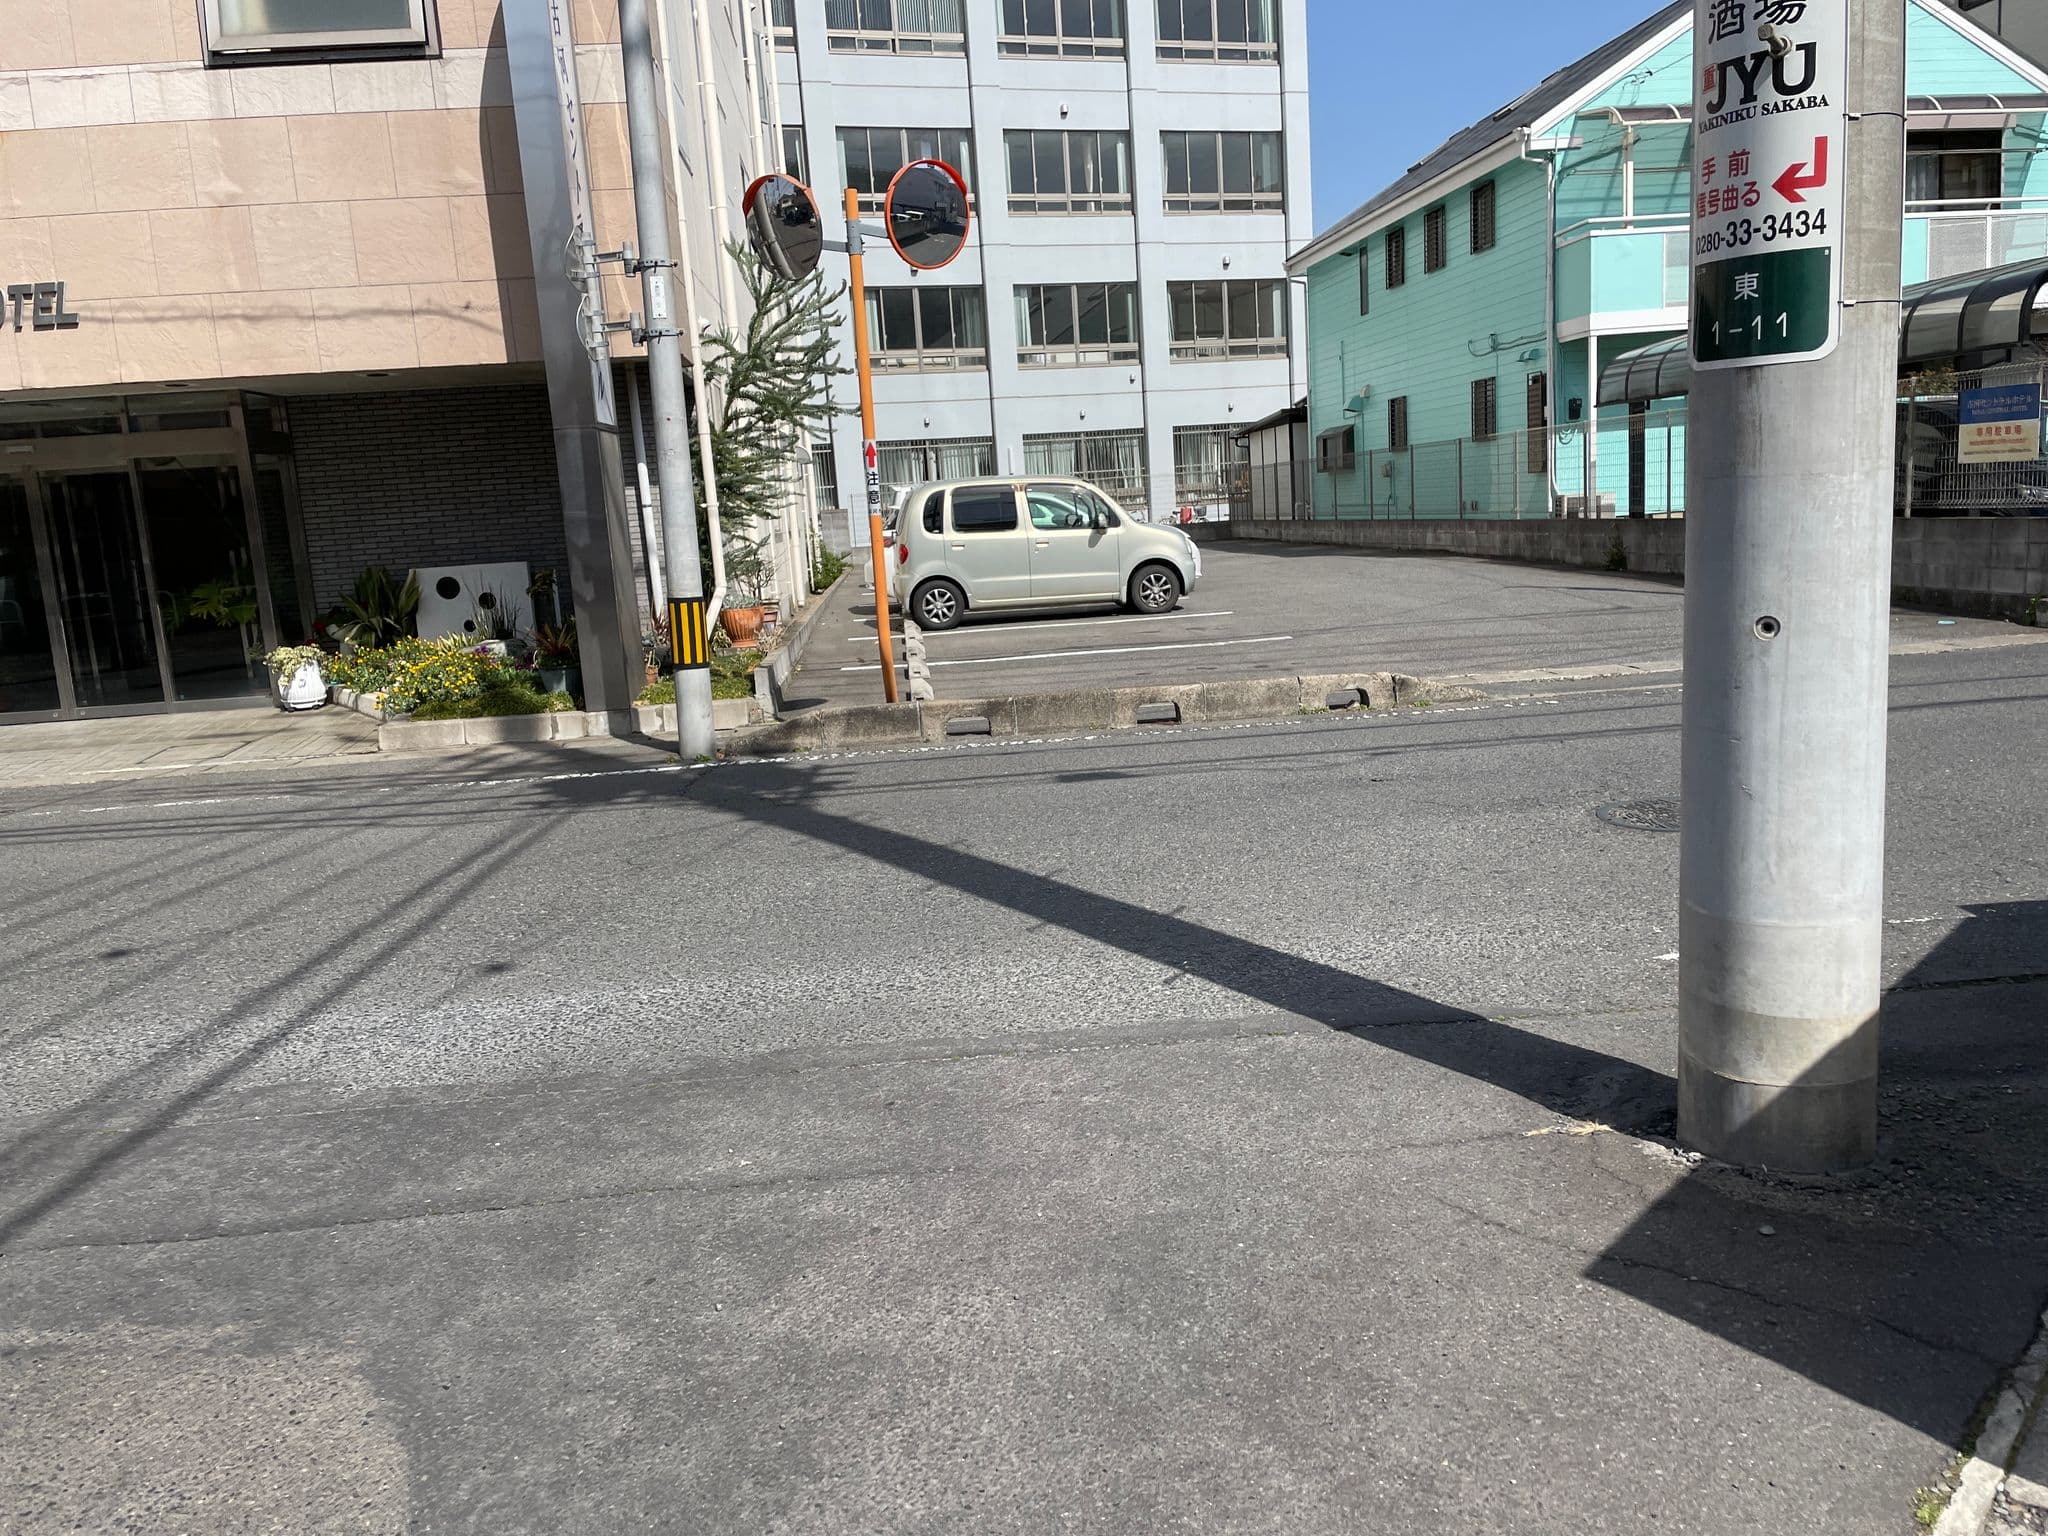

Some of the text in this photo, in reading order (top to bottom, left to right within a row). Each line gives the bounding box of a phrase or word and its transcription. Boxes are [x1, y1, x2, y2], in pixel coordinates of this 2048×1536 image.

[1707, 0, 1808, 45] 酒場
[1706, 41, 1817, 115] JYU
[1698, 94, 1829, 134] YAKINIKU SAKABA
[1701, 150, 1750, 186] 手前
[1696, 180, 1761, 220] 信号曲る
[1696, 207, 1827, 256] 0280-33-3434
[1733, 271, 1760, 301] 東
[0, 280, 80, 333] TEL
[866, 471, 881, 505] 注意
